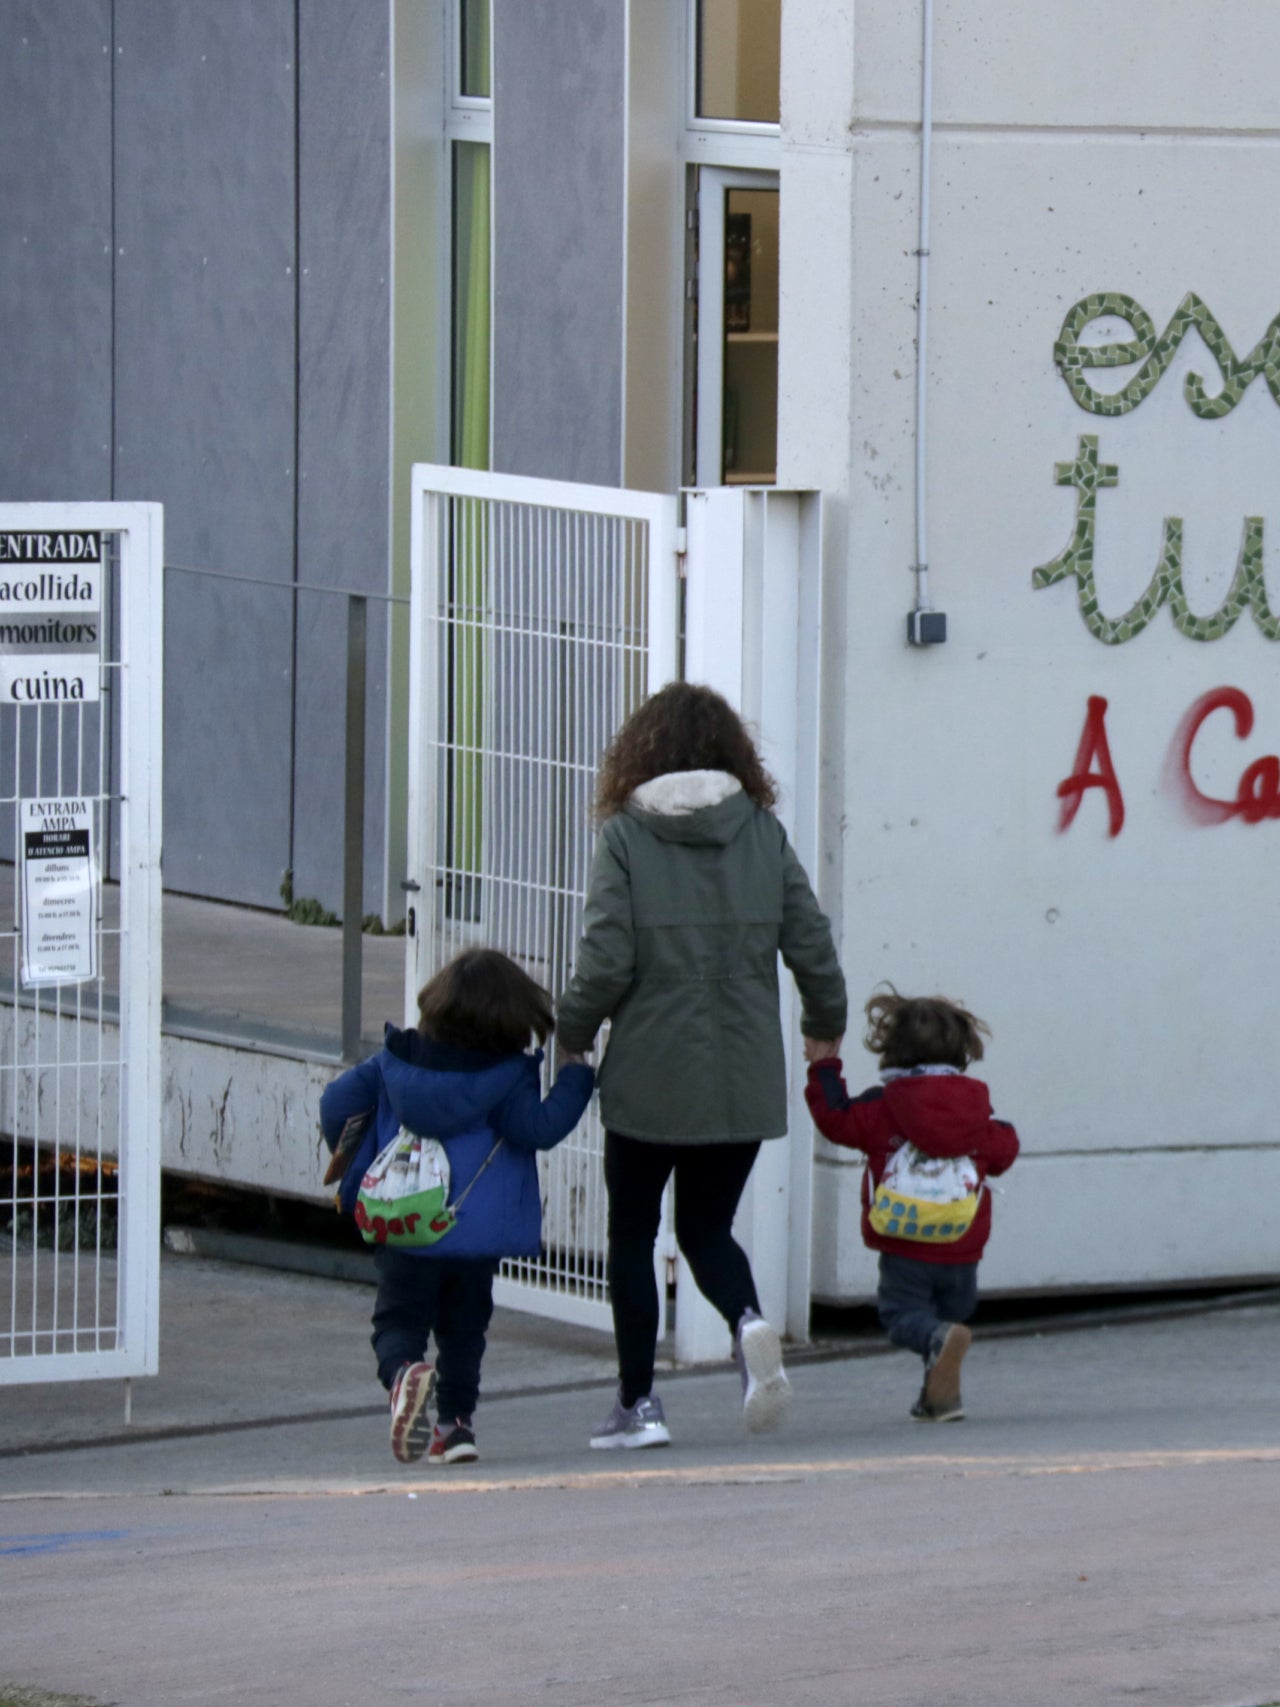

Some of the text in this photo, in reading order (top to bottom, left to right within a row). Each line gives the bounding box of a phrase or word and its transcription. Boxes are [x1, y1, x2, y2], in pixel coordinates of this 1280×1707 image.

[0, 534, 98, 559] ENTRADA
[0, 573, 93, 602] acollida
[0, 618, 97, 644] monitors
[10, 670, 84, 701] cuina
[1055, 694, 1125, 838] A
[30, 801, 86, 816] ENTRADA
[41, 817, 76, 831] AMPA
